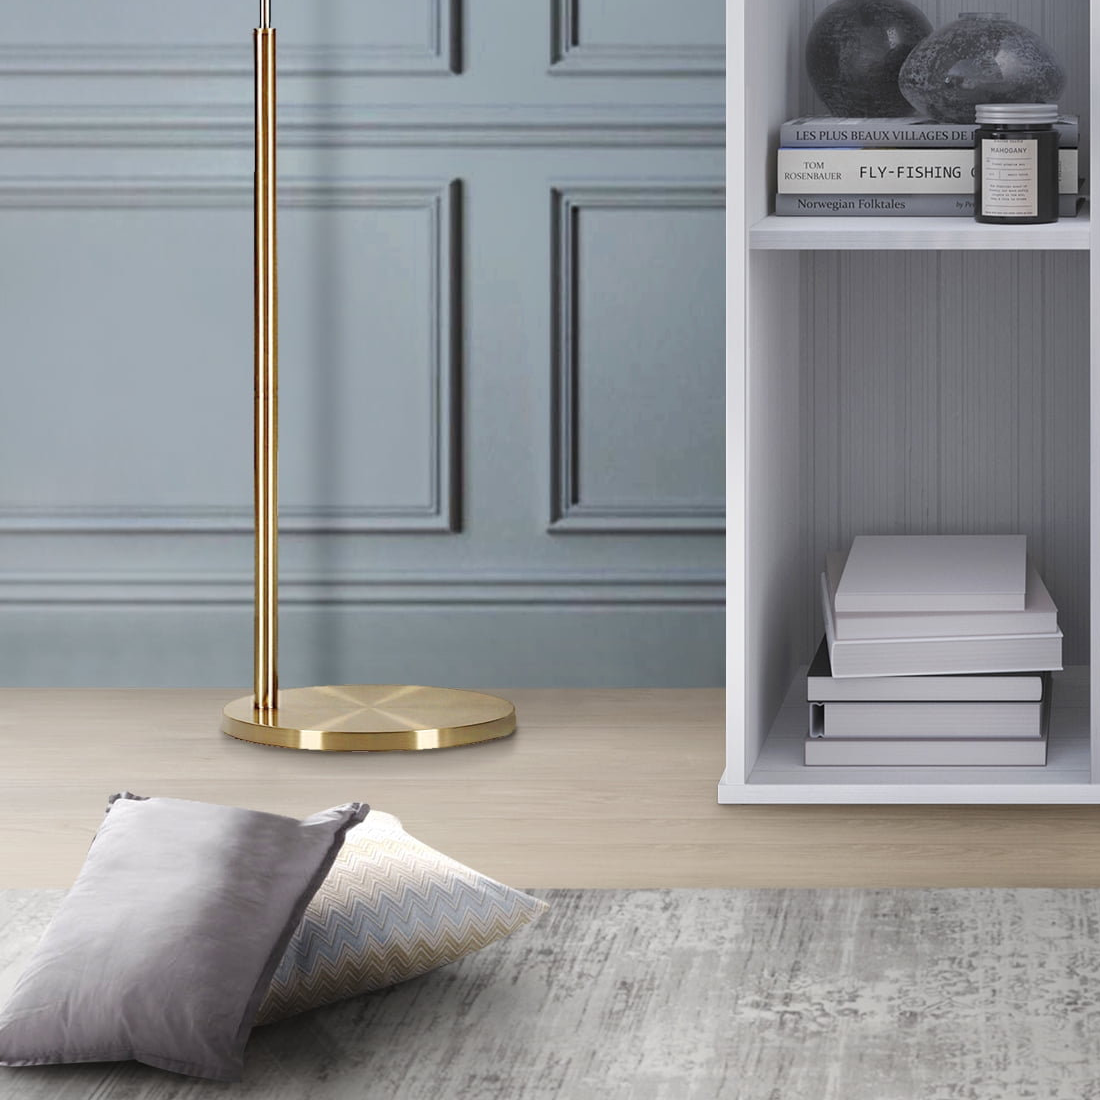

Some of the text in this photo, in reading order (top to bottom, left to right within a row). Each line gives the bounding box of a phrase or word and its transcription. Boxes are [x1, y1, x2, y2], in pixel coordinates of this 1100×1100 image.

[796, 131, 818, 140] LES
[819, 131, 848, 140] PLUS
[851, 131, 890, 140] BEAUX
[891, 131, 949, 140] VILLAGES
[951, 131, 968, 140] DE
[804, 162, 824, 170] TOM
[784, 172, 842, 180] ROSENBAUER
[859, 166, 962, 178] FLY-FISHING
[798, 199, 906, 211] Norwegian Folktales
